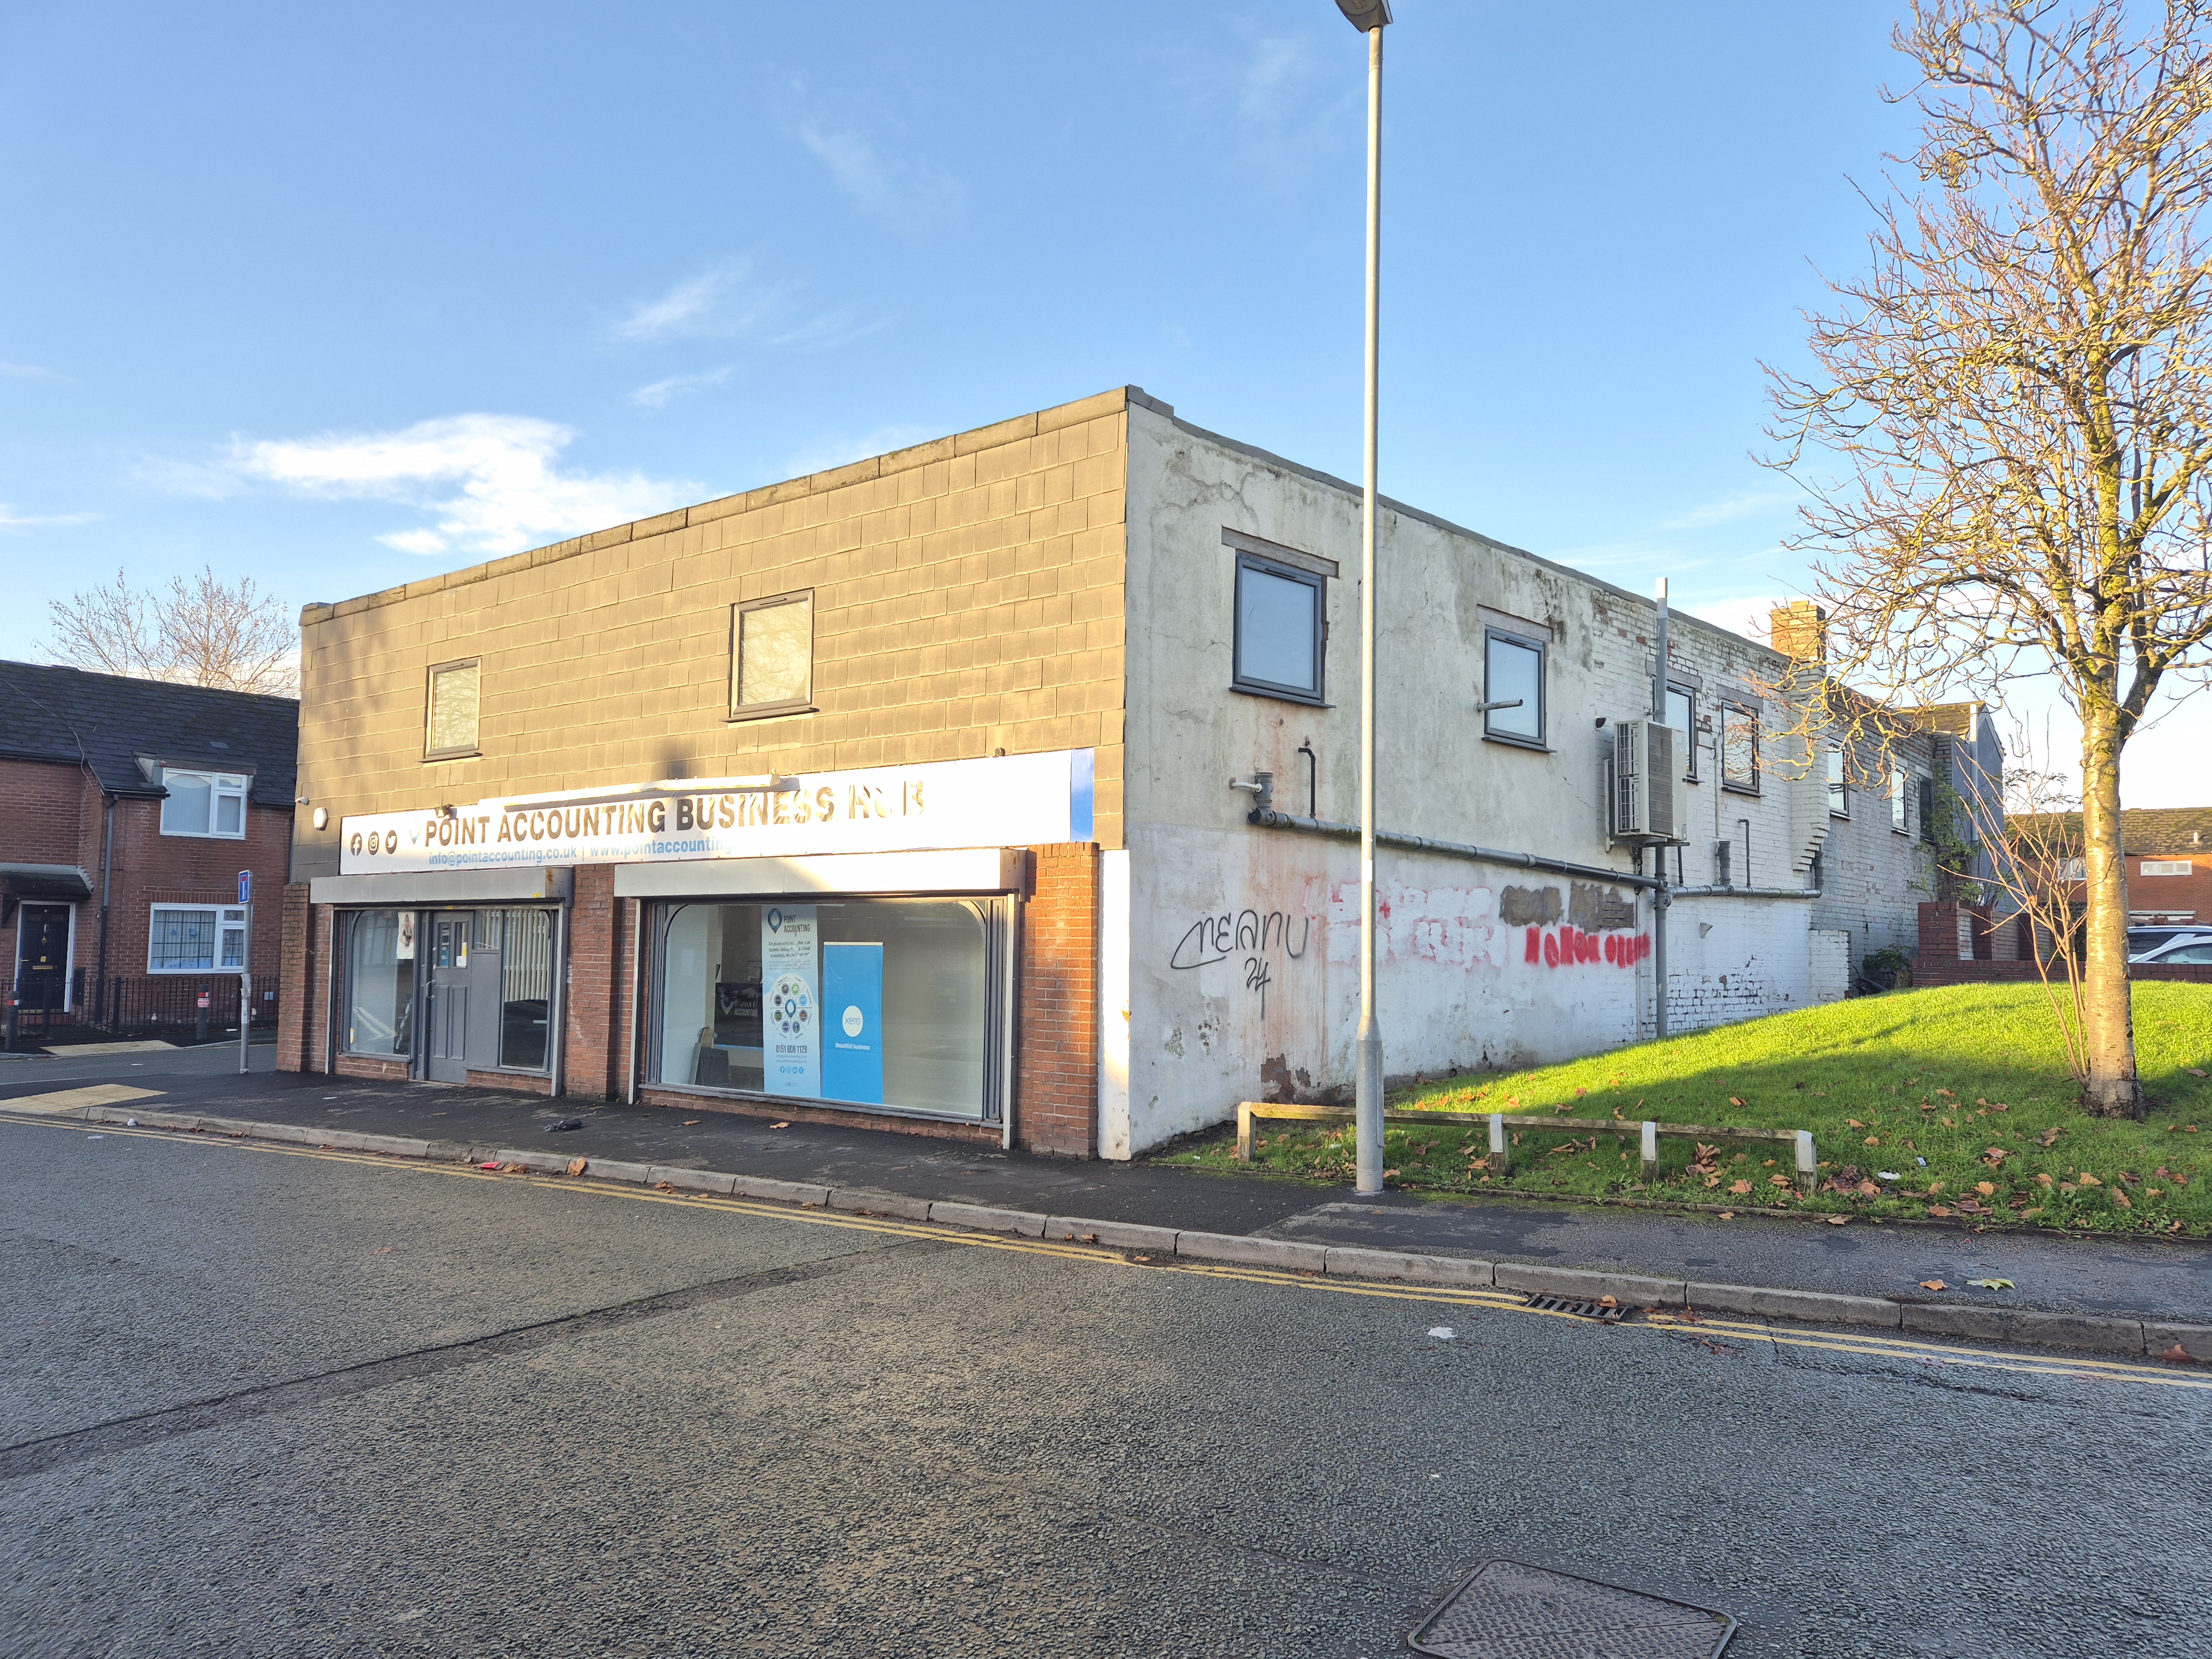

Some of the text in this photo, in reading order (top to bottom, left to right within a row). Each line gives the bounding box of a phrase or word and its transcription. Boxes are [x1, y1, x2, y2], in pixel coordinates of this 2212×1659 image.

[425, 816, 490, 847] POINT
[498, 800, 666, 843] ACCOUNTING
[676, 786, 836, 831] BUSINESS
[429, 845, 578, 867] info@pointaccounting.co.uk
[784, 915, 796, 924] POINT
[784, 924, 811, 933] ACCOUNTING
[734, 1008, 759, 1018] ACCOUNTING
[844, 1017, 861, 1025] xero
[776, 1045, 807, 1053] 0151 808 1129
